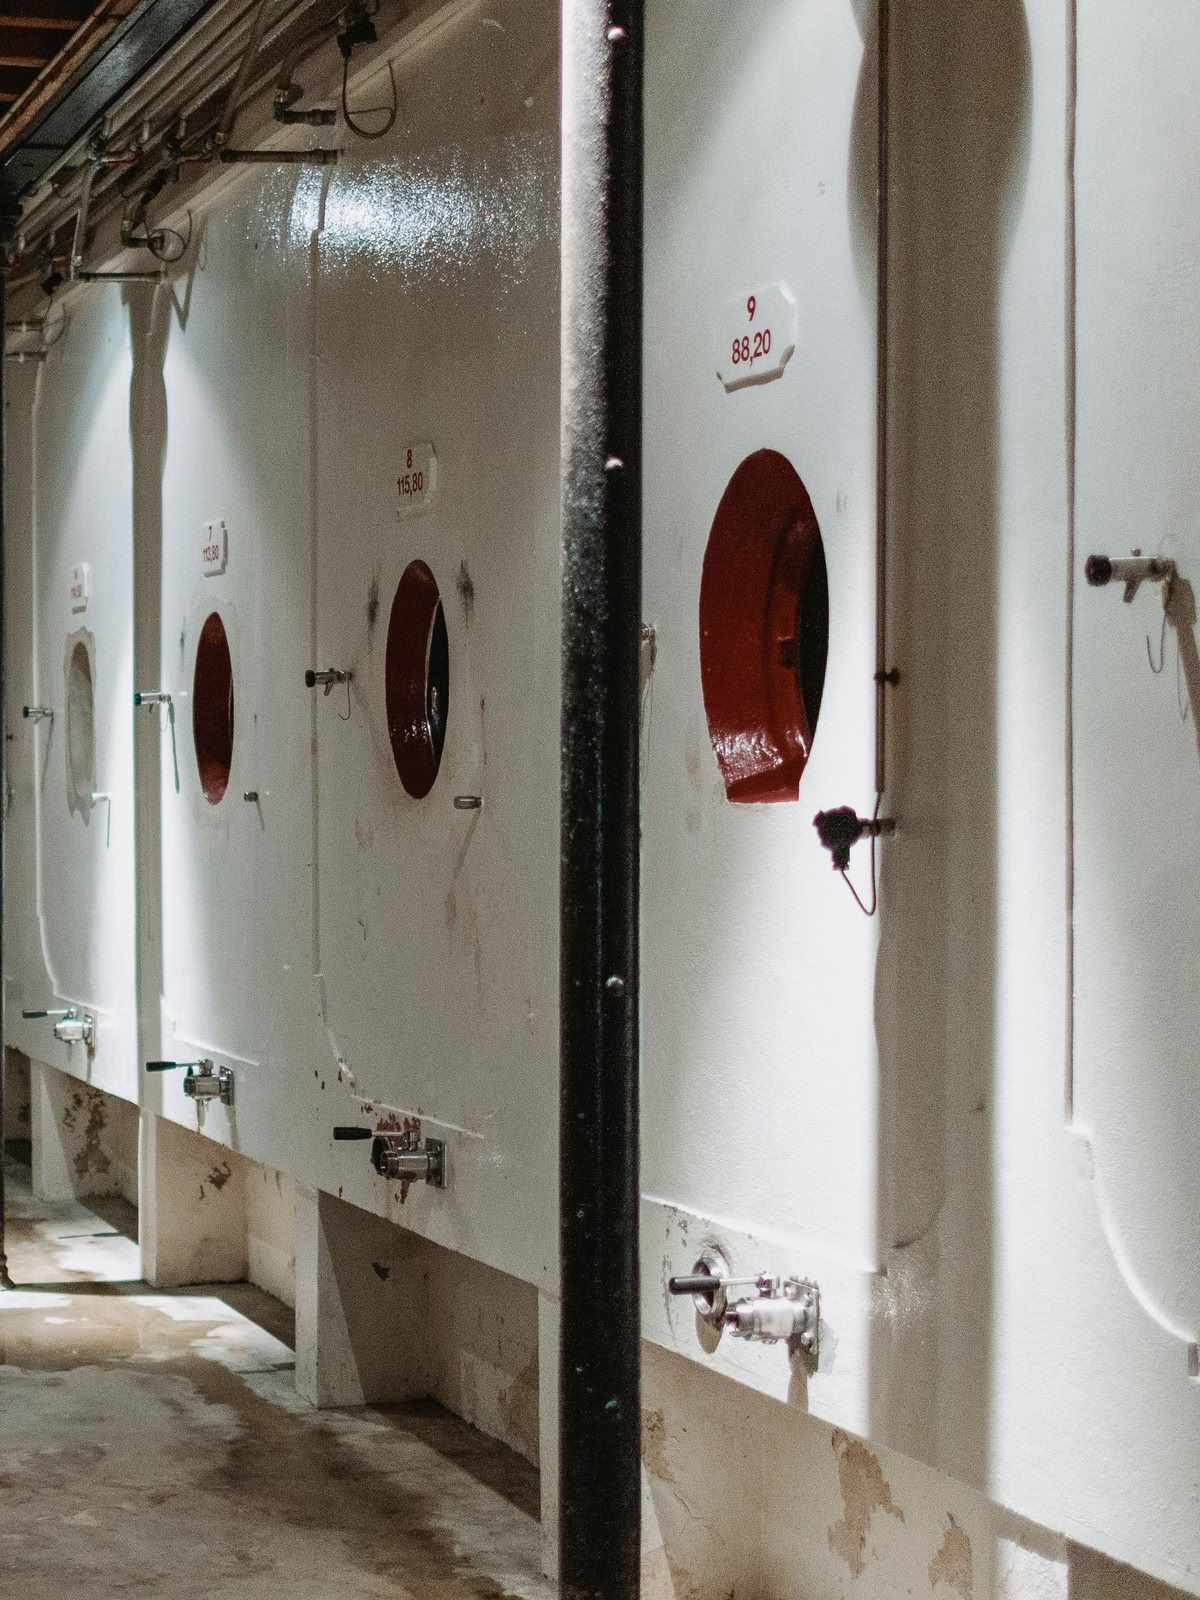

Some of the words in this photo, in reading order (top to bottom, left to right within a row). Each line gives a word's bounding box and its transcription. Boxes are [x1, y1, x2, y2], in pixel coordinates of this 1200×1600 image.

[747, 295, 756, 322] 9
[731, 329, 771, 367] 88,20
[407, 449, 412, 469] 8
[397, 472, 423, 497] 115,80
